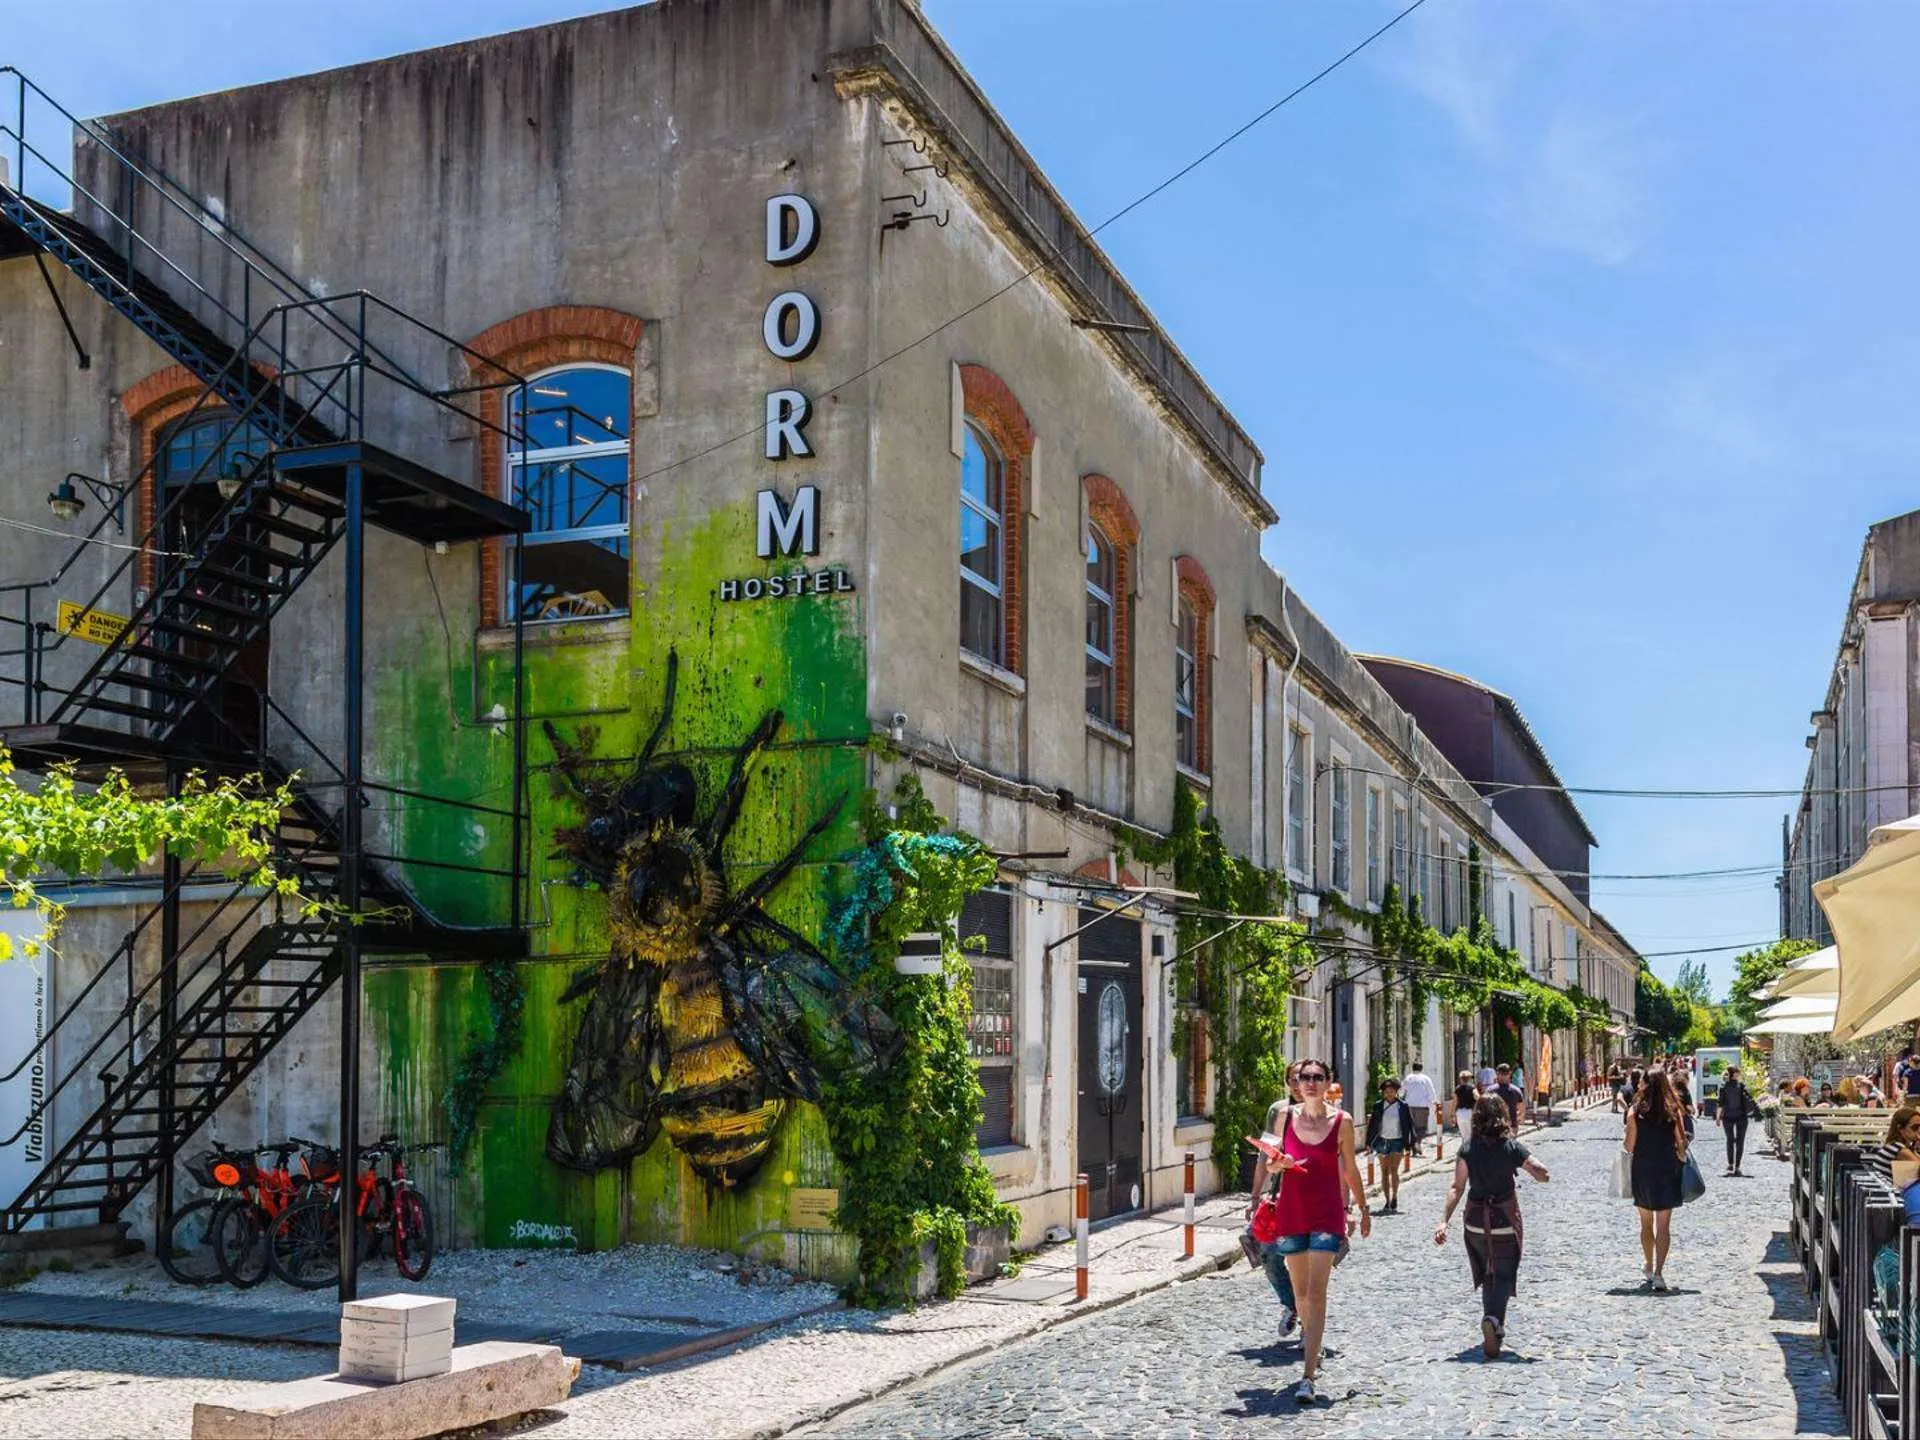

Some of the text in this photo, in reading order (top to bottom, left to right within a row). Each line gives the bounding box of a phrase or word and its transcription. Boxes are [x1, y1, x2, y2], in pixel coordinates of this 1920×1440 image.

[756, 193, 820, 560] DORM
[719, 570, 855, 600] HOSTEL
[89, 614, 125, 631] DANGE
[25, 1065, 43, 1163] Viabizzuno
